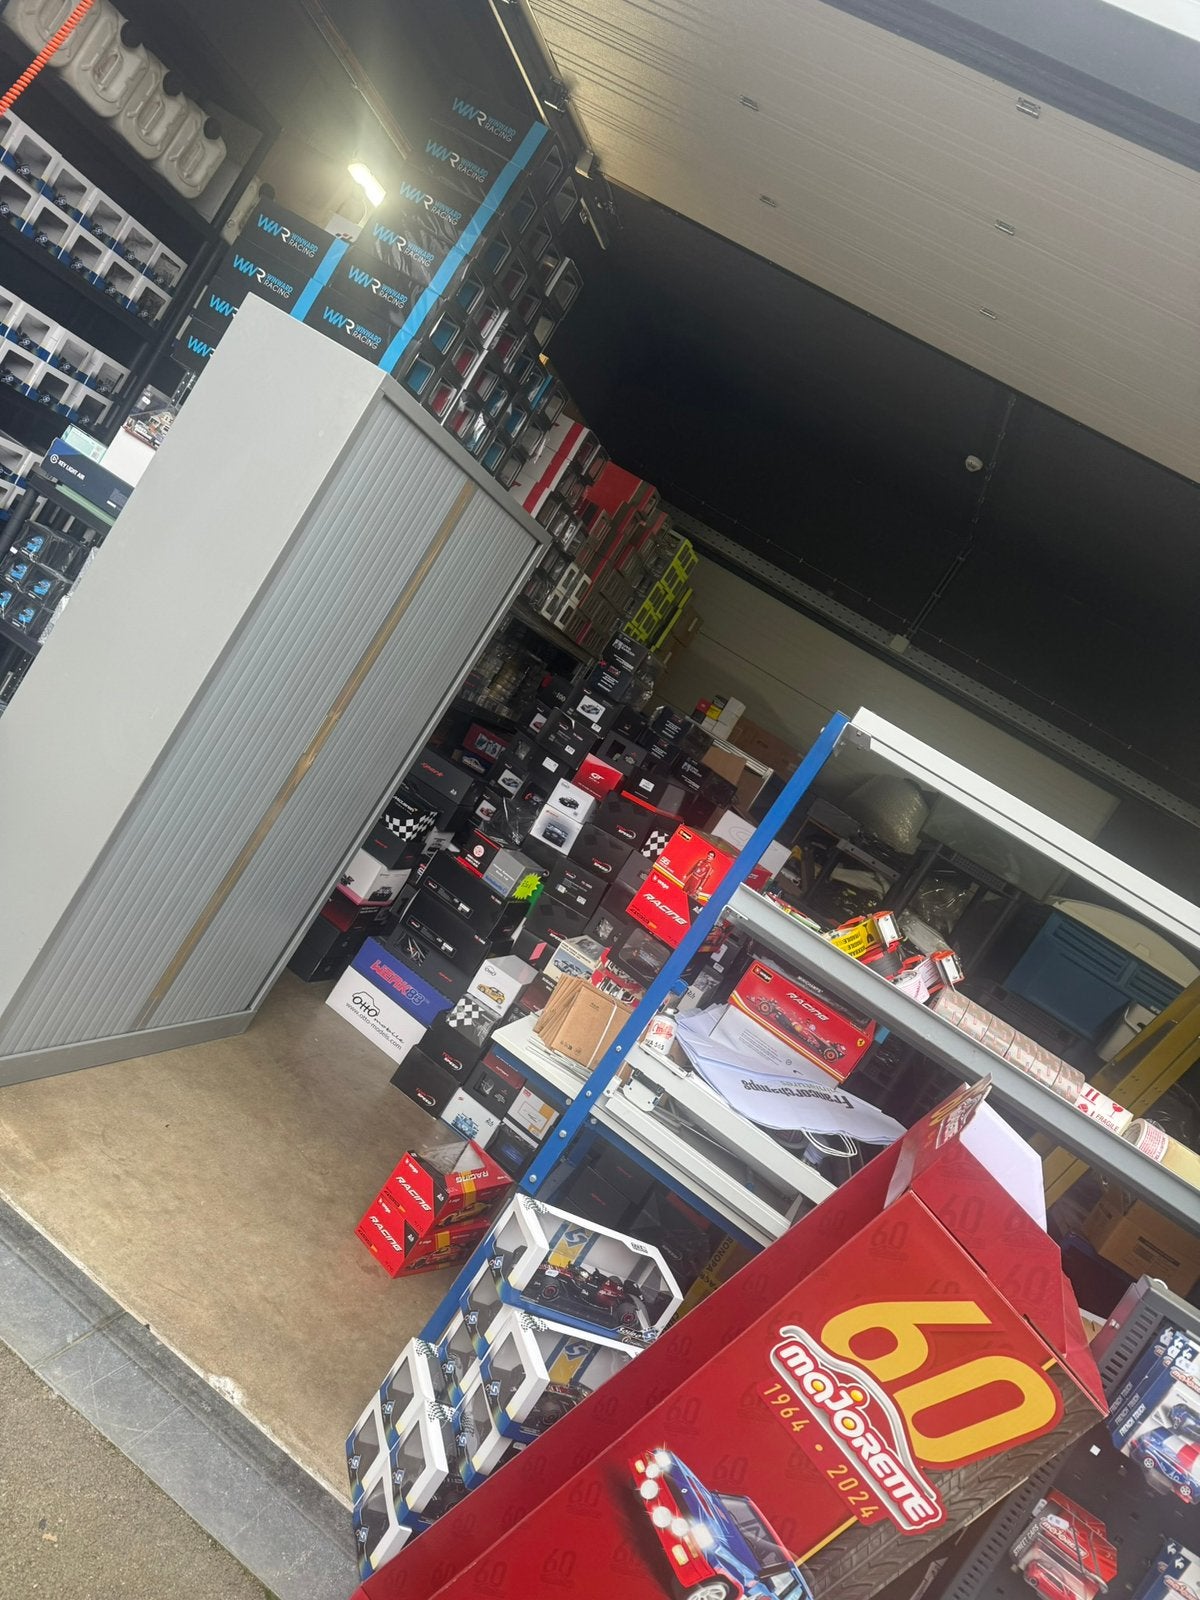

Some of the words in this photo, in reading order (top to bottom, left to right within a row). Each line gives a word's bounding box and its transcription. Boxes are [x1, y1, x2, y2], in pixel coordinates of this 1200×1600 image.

[484, 122, 513, 143] RACING
[486, 116, 516, 137] WINWARD
[456, 164, 485, 184] RACING
[459, 158, 488, 178] WINWARD
[430, 206, 459, 226] RACING
[433, 200, 462, 220] WINWARD
[288, 237, 315, 259] RACING
[290, 232, 318, 254] WINWARD
[406, 242, 434, 262] WINWARD
[403, 247, 431, 268] RACING
[263, 278, 290, 299] RACING
[265, 272, 294, 294] WINWARD
[381, 284, 408, 303] WINWARD
[378, 289, 405, 310] RACING
[352, 330, 379, 351] RACING
[355, 325, 382, 346] WINWARD
[58, 459, 69, 470] KEY
[66, 464, 79, 477] LIGHT
[77, 471, 86, 481] AIR
[643, 893, 688, 925] RACING
[786, 992, 829, 1021] RACING
[346, 1002, 402, 1050] www.otto-models.com
[741, 1079, 854, 1109] Francorchamps
[1095, 1113, 1119, 1131] FRAGILE
[455, 1170, 489, 1184] RACING
[395, 1176, 432, 1213] RACING
[368, 1215, 403, 1252] RACING
[821, 1300, 1056, 1463] 60
[1127, 1393, 1140, 1410] TOUCH
[1119, 1417, 1136, 1437] FRENCH
[1132, 1403, 1146, 1420] TOUCH
[763, 1383, 809, 1433] 1964
[826, 1464, 880, 1518] 2024
[1013, 1537, 1027, 1557] STREET
[1027, 1524, 1039, 1540] CARS
